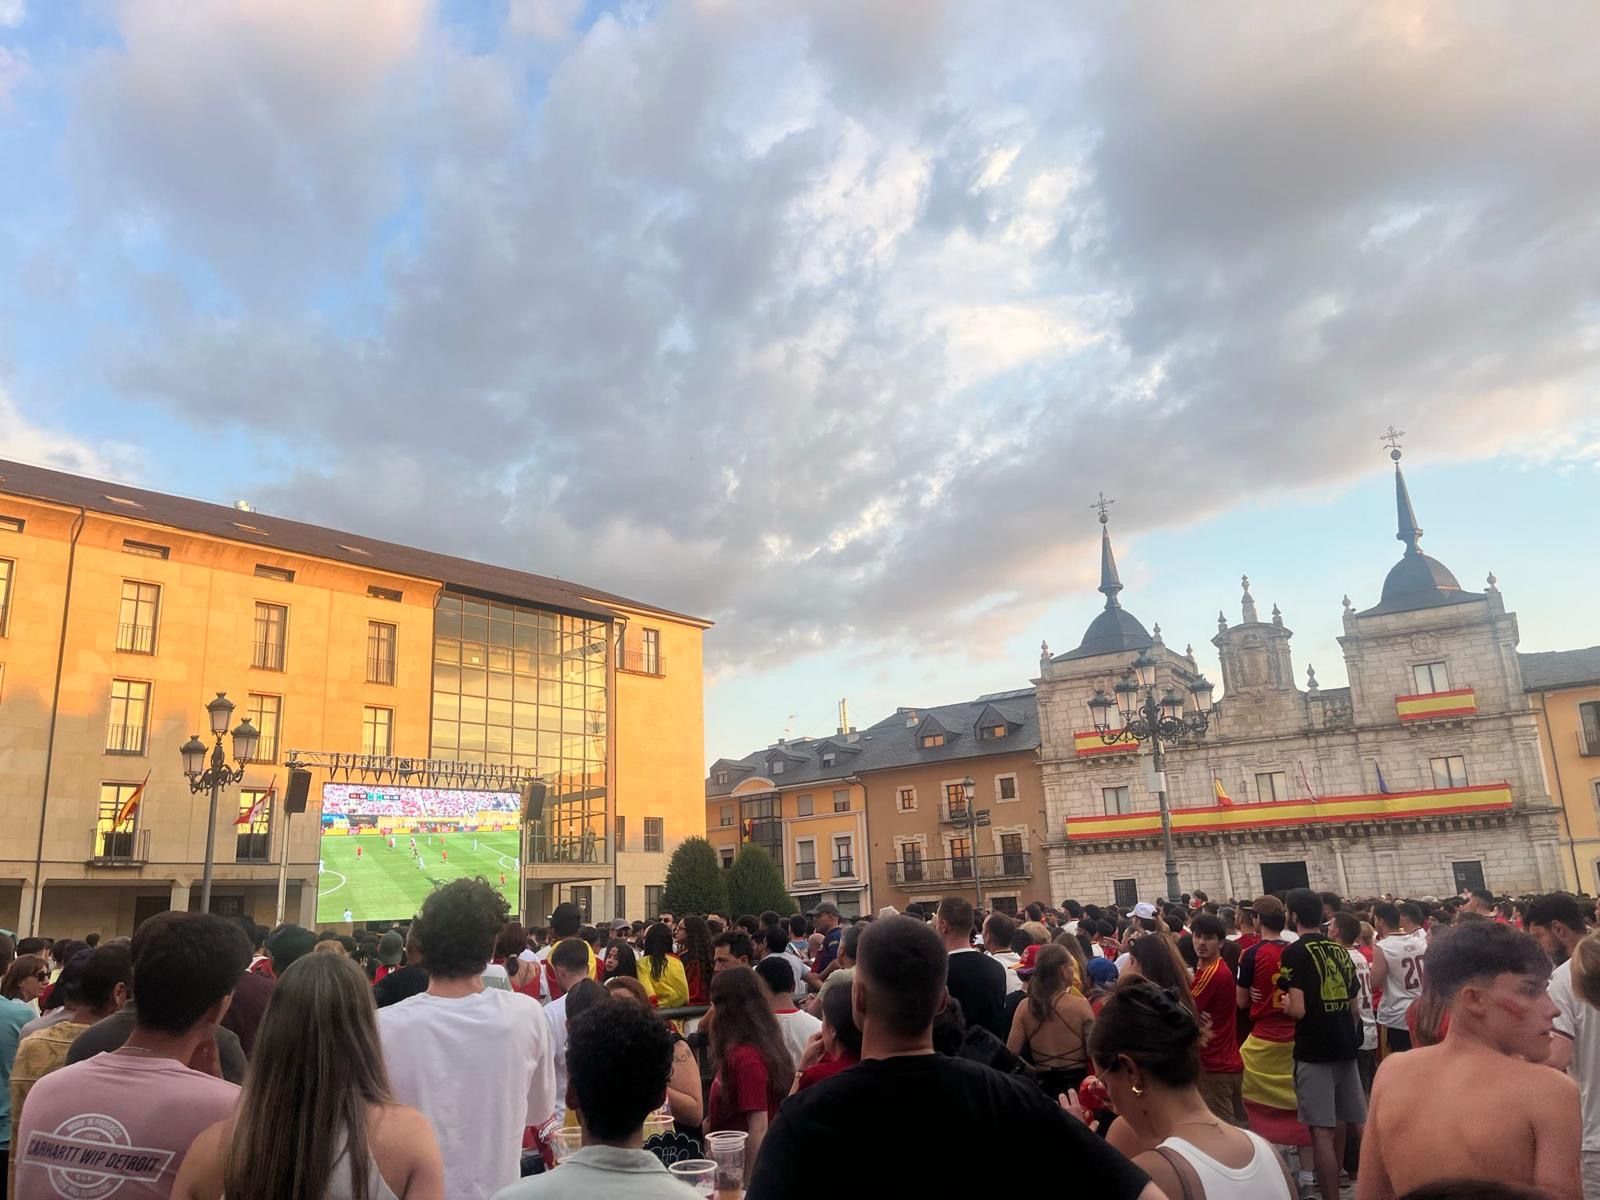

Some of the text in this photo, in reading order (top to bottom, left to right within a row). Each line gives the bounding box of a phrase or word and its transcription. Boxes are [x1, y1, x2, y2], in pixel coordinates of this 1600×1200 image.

[27, 1139, 161, 1172] CARHARTT WIP DETROIT
